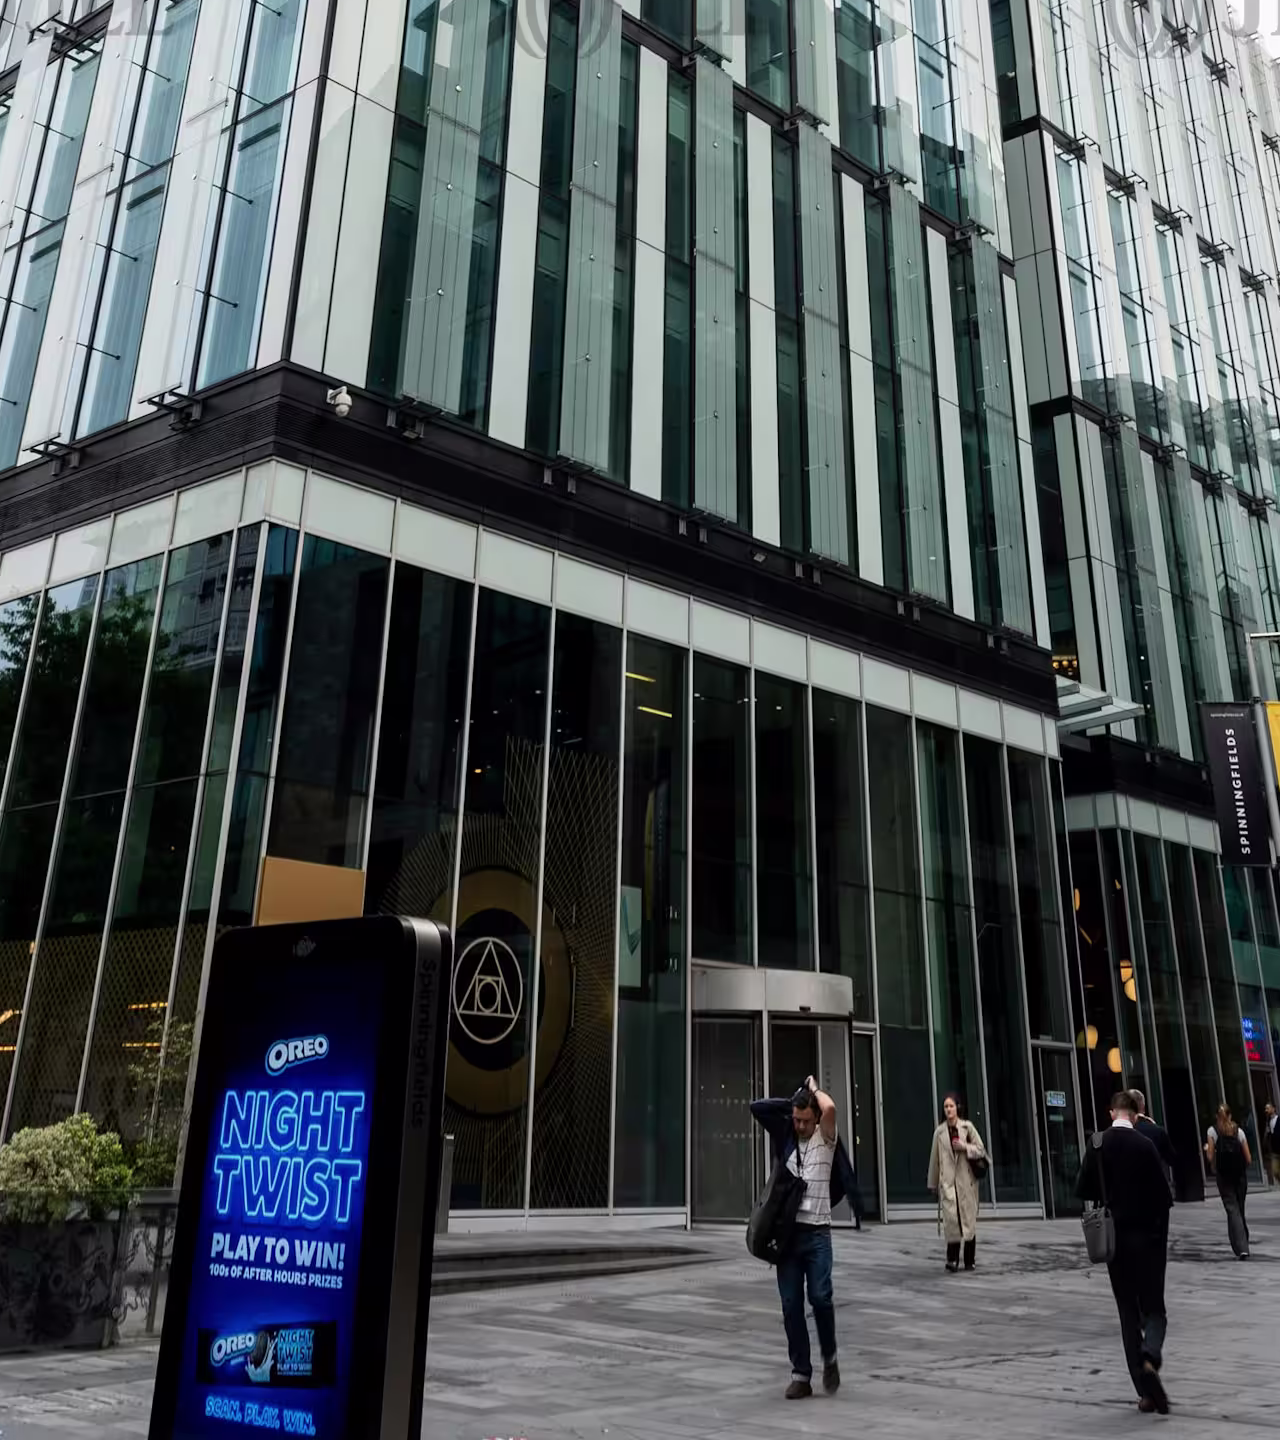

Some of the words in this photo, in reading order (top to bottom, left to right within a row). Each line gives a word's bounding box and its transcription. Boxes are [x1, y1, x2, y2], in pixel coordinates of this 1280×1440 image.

[1225, 728, 1251, 855] SPINNINGFIELDS
[267, 1036, 328, 1070] OREO
[220, 1090, 365, 1152] NIGHT
[214, 1154, 363, 1223] TWIST
[210, 1231, 261, 1262] PLAY
[264, 1236, 290, 1265] TO
[294, 1239, 346, 1271] WIN!
[209, 1263, 229, 1278] 100s
[230, 1265, 242, 1278] OF
[243, 1266, 272, 1281] AFTER
[274, 1270, 307, 1286] HOURS
[308, 1273, 343, 1289] PRIZES
[212, 1333, 255, 1362] OREO
[277, 1329, 315, 1344] NIGHT
[277, 1345, 313, 1362] TWIST
[205, 1396, 241, 1421] SCAN.
[244, 1403, 279, 1429] PLAY.
[283, 1409, 316, 1436] WIN.
